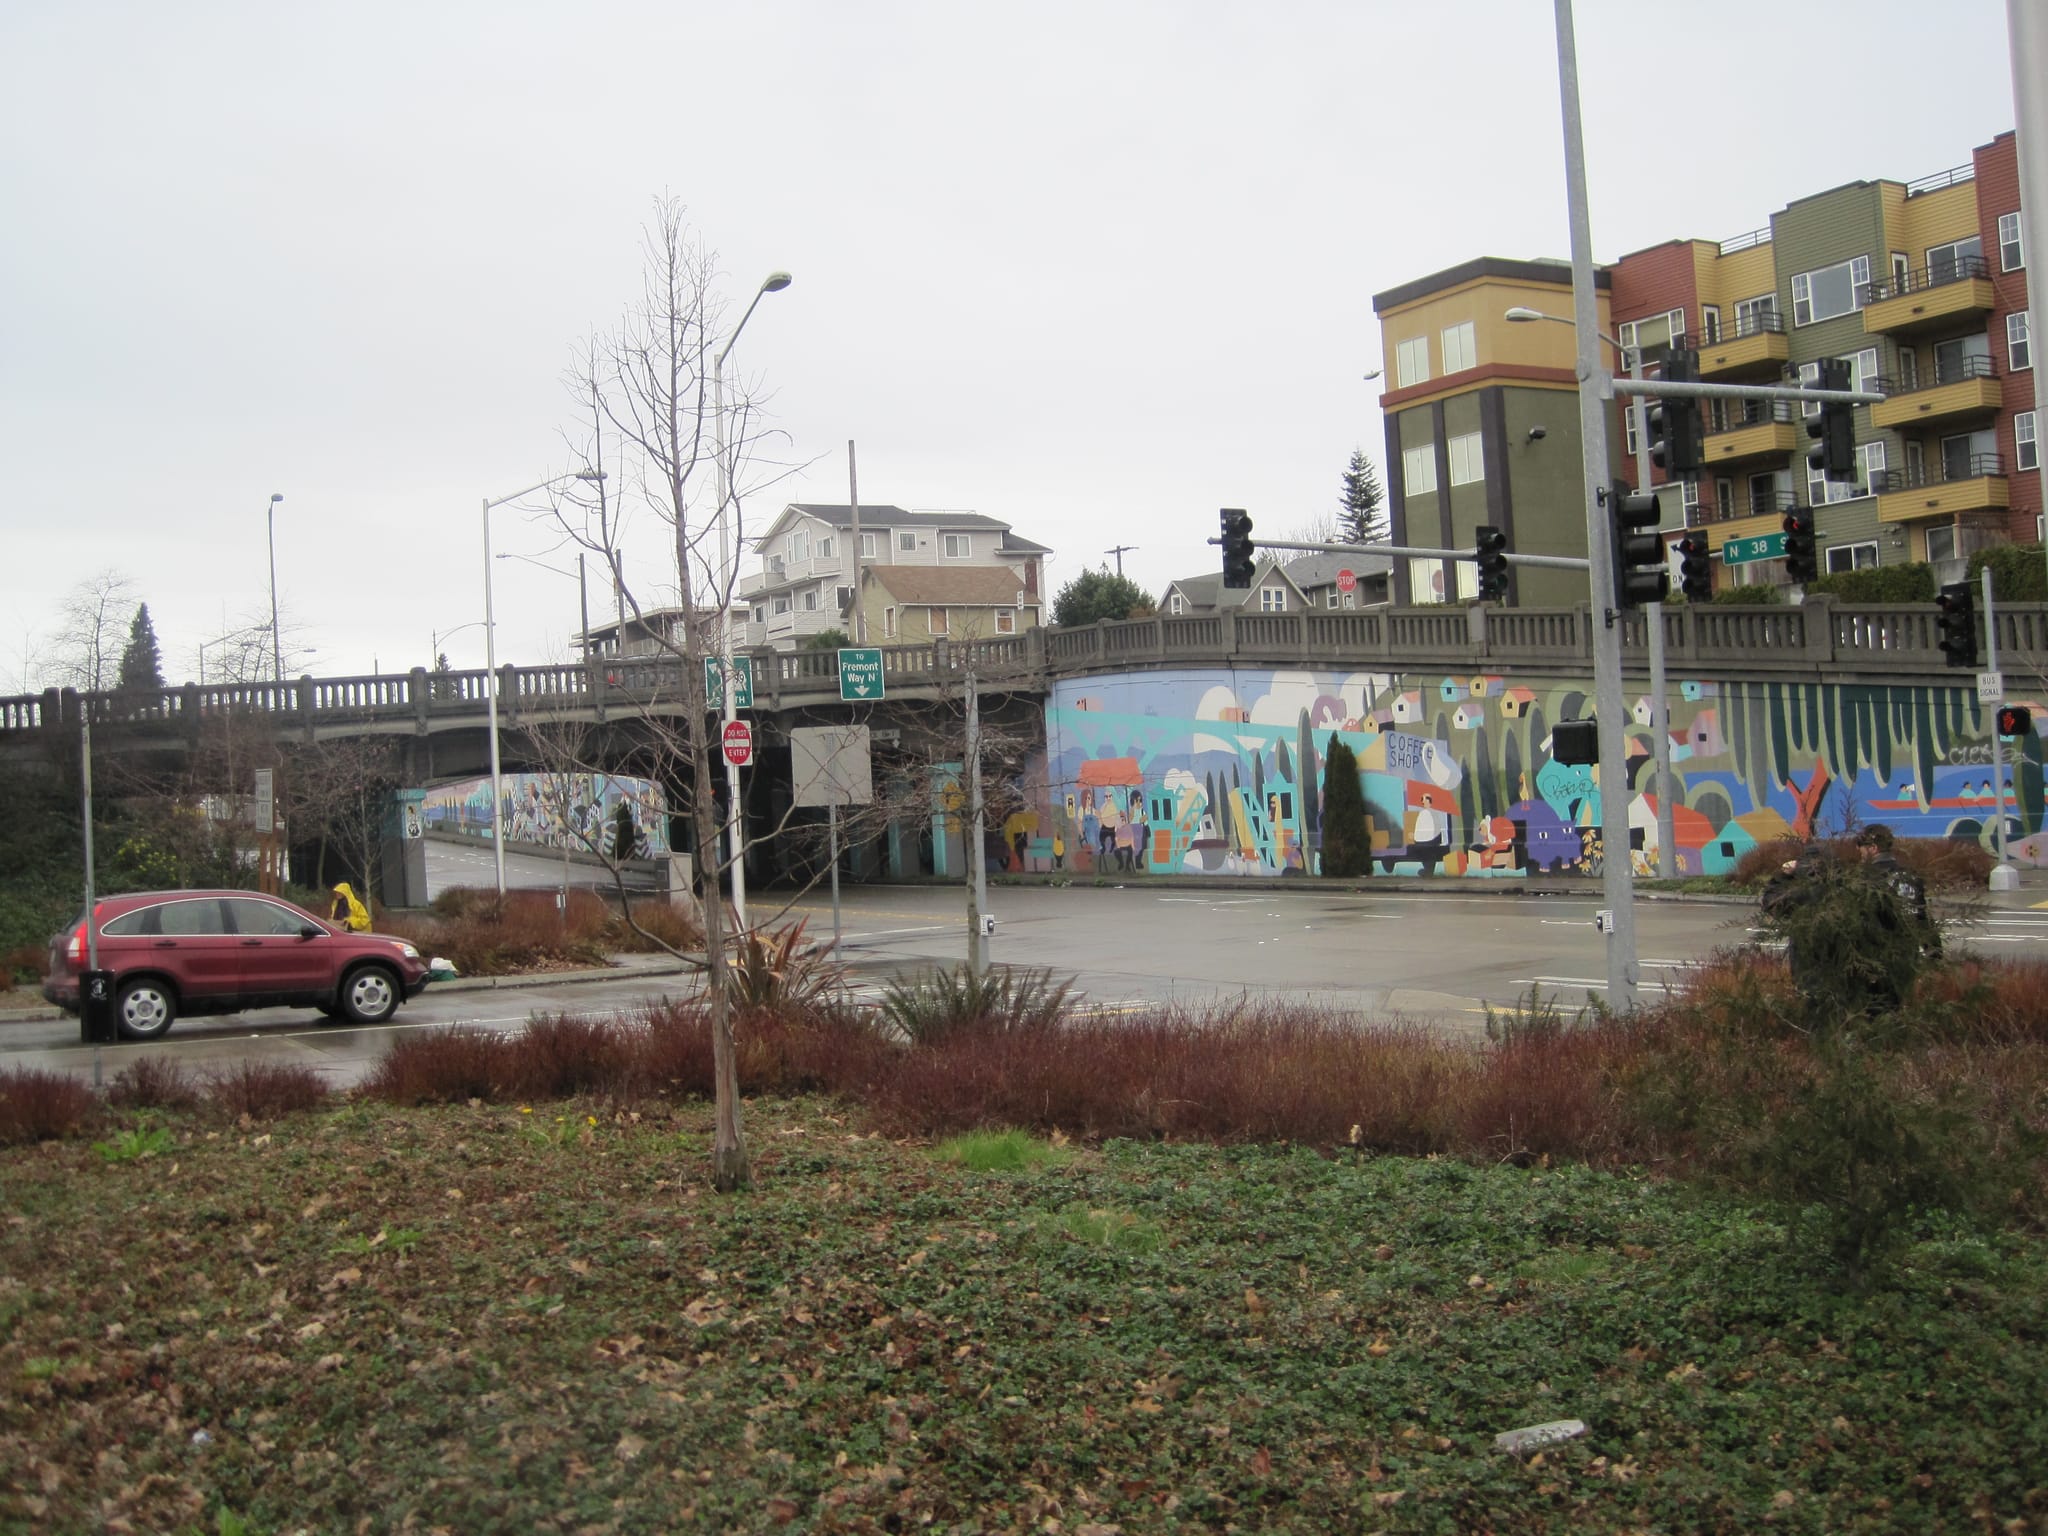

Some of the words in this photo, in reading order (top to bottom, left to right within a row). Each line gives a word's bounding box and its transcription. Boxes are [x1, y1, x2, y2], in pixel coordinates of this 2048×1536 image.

[1729, 545, 1739, 558] N
[1752, 540, 1767, 554] 38
[1780, 535, 1789, 550] S
[1338, 575, 1356, 585] STOP
[842, 662, 879, 672] Fremont
[847, 673, 865, 684] Way
[868, 673, 876, 682] N
[1982, 676, 1996, 685] BUS
[1979, 688, 2000, 697] SIGNAL
[727, 729, 736, 738] DO
[736, 729, 747, 737] NOT
[728, 749, 747, 757] ENTER
[1390, 750, 1420, 769] SHOP
